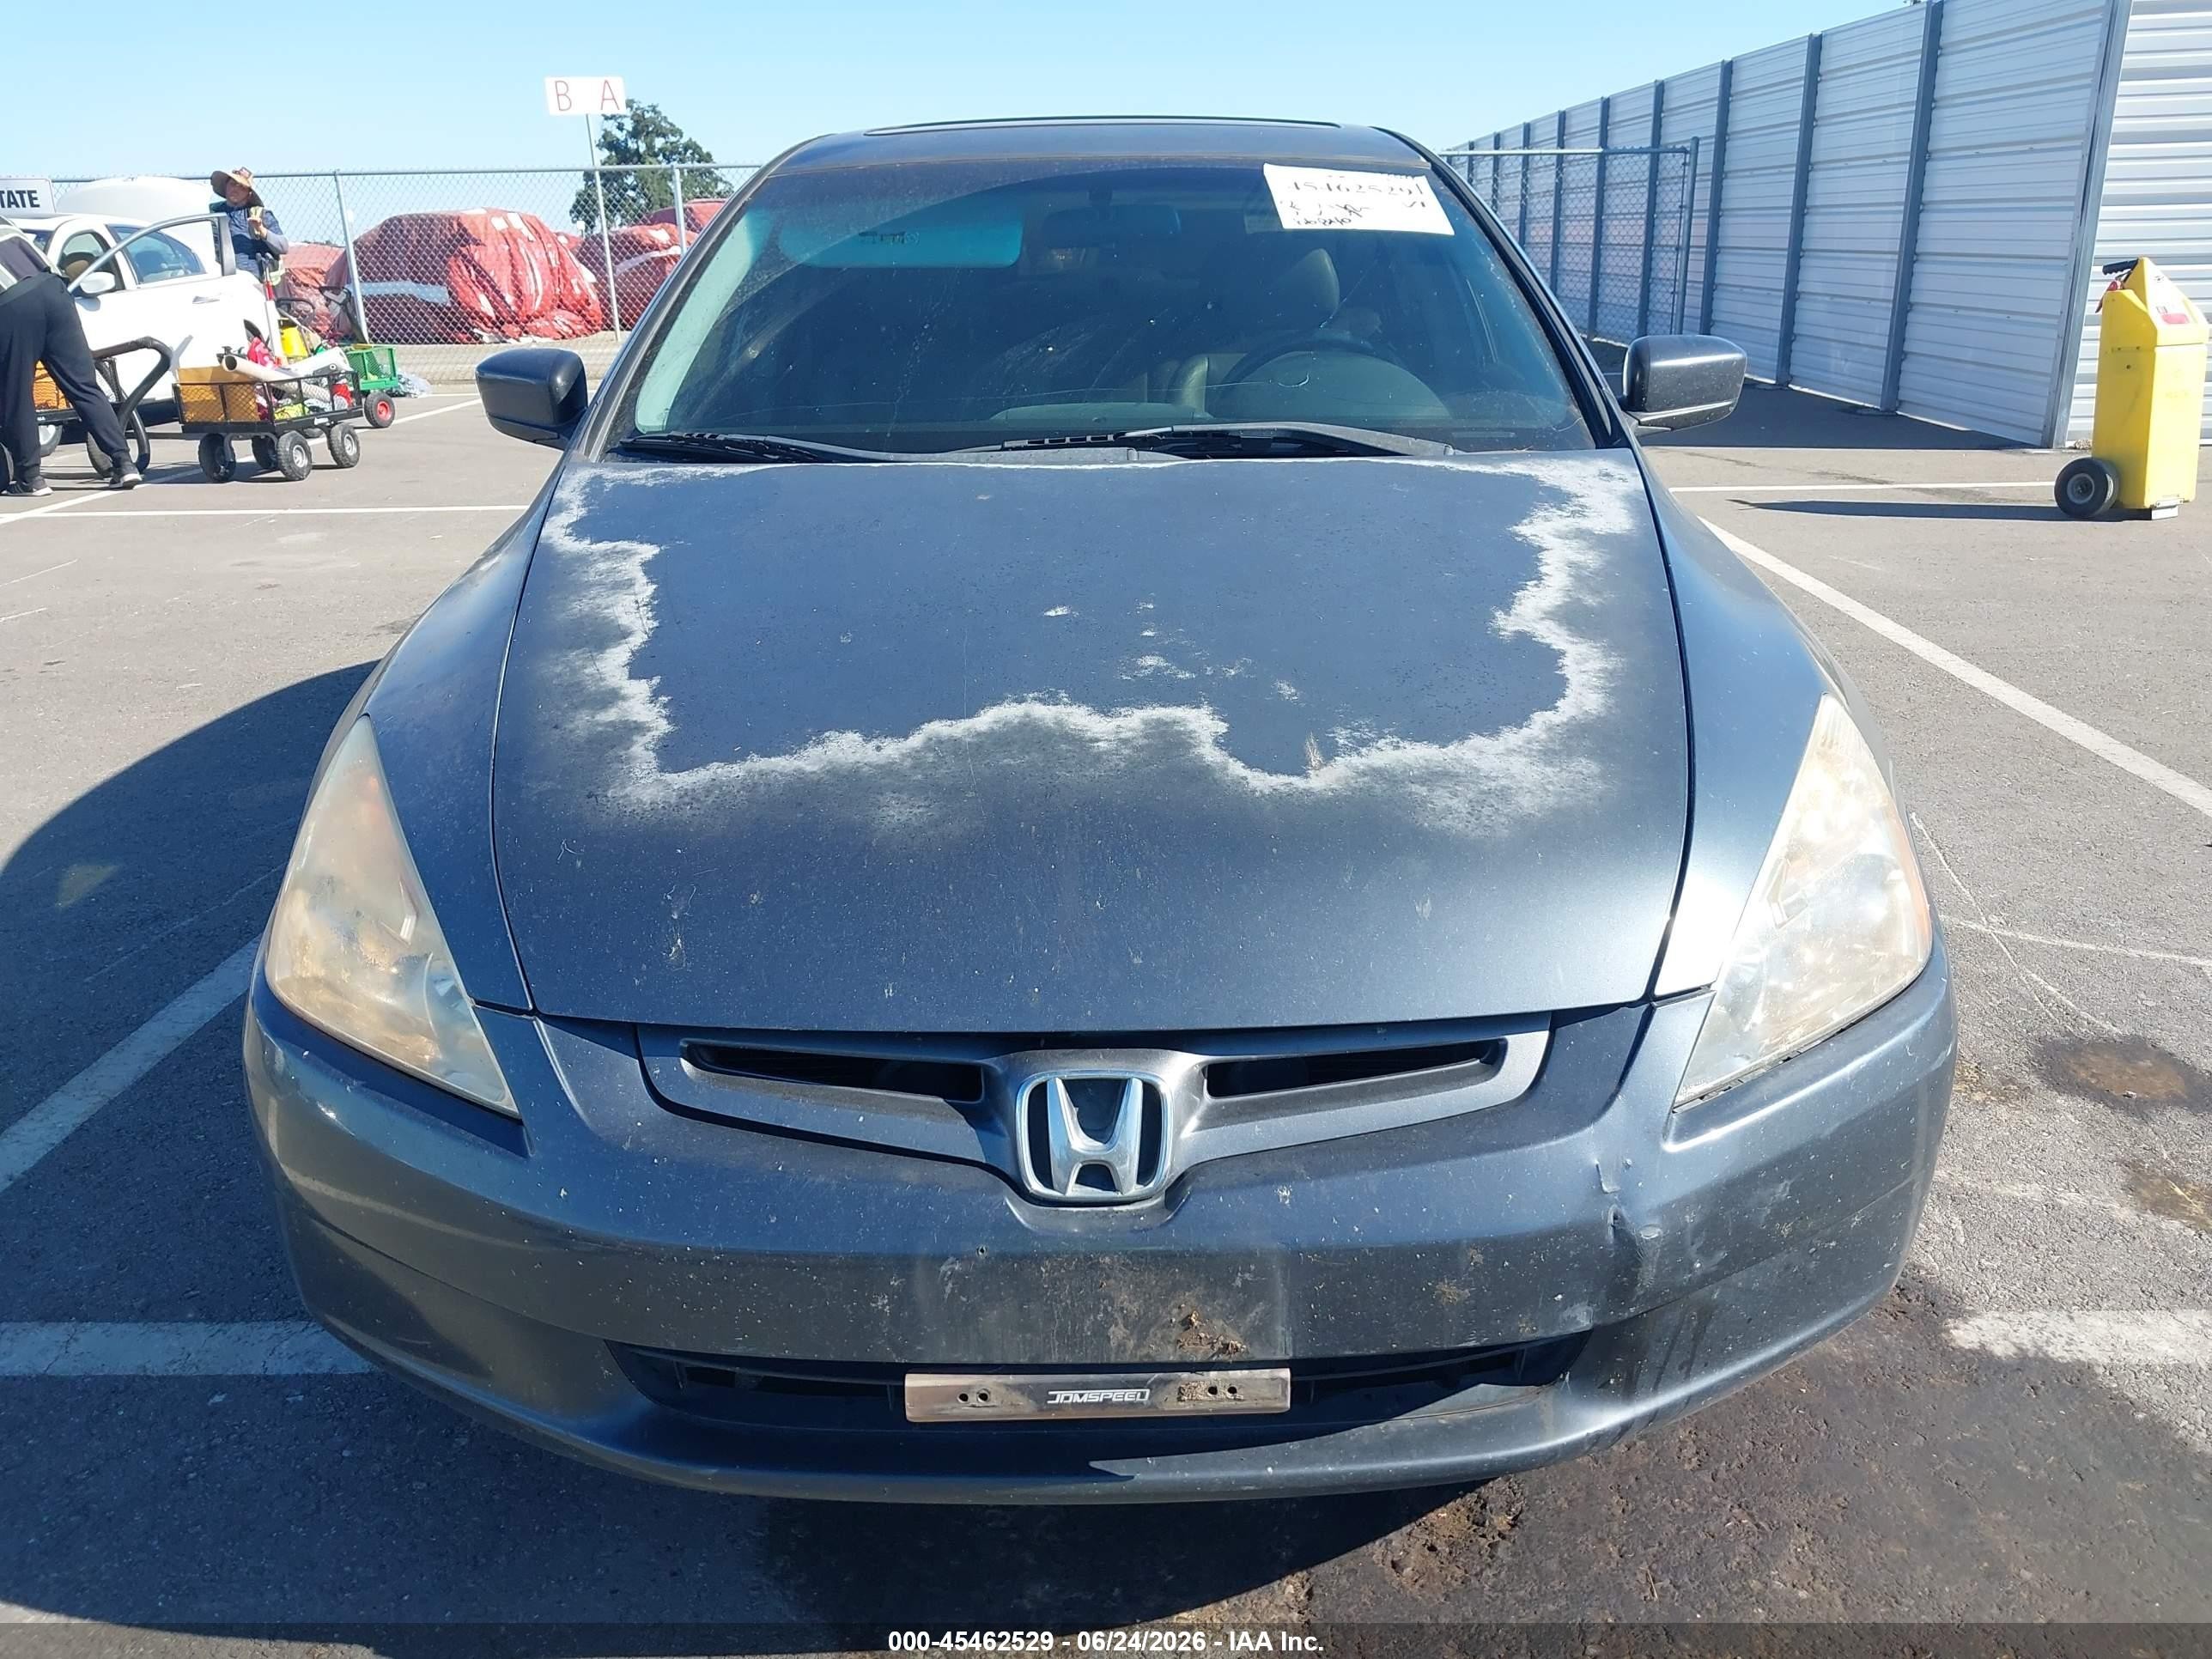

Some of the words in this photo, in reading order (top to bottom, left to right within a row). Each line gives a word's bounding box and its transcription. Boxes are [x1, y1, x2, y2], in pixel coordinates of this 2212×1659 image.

[555, 80, 572, 112] B
[600, 79, 620, 110] A
[1047, 1389, 1151, 1404] JDMSPEED
